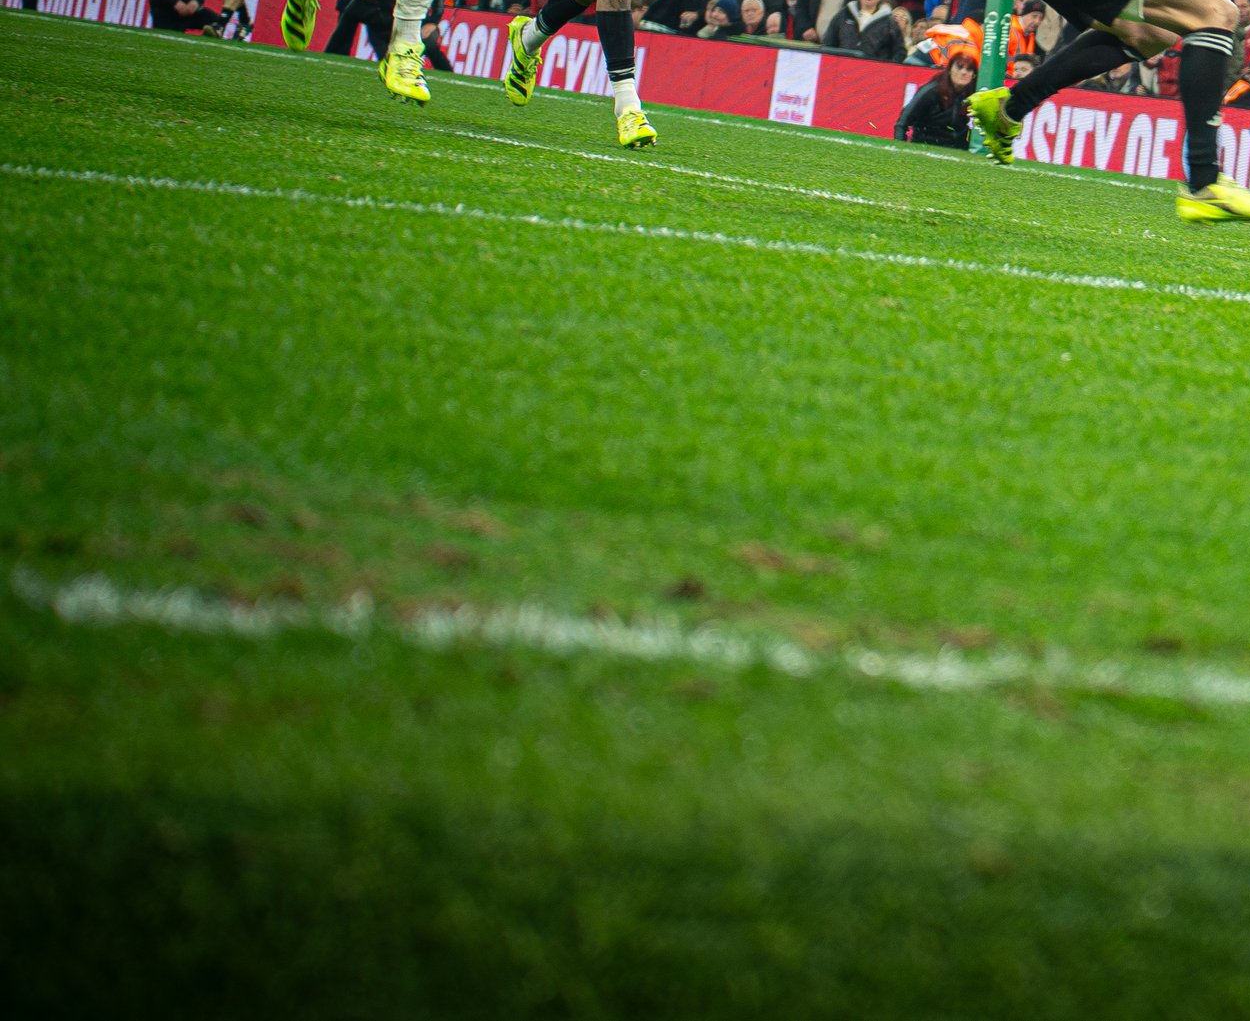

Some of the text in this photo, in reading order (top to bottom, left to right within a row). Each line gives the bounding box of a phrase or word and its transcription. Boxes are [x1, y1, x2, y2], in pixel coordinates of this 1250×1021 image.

[983, 10, 999, 57] Quilter
[999, 13, 1011, 59] Quilter
[1123, 113, 1178, 178] OF
